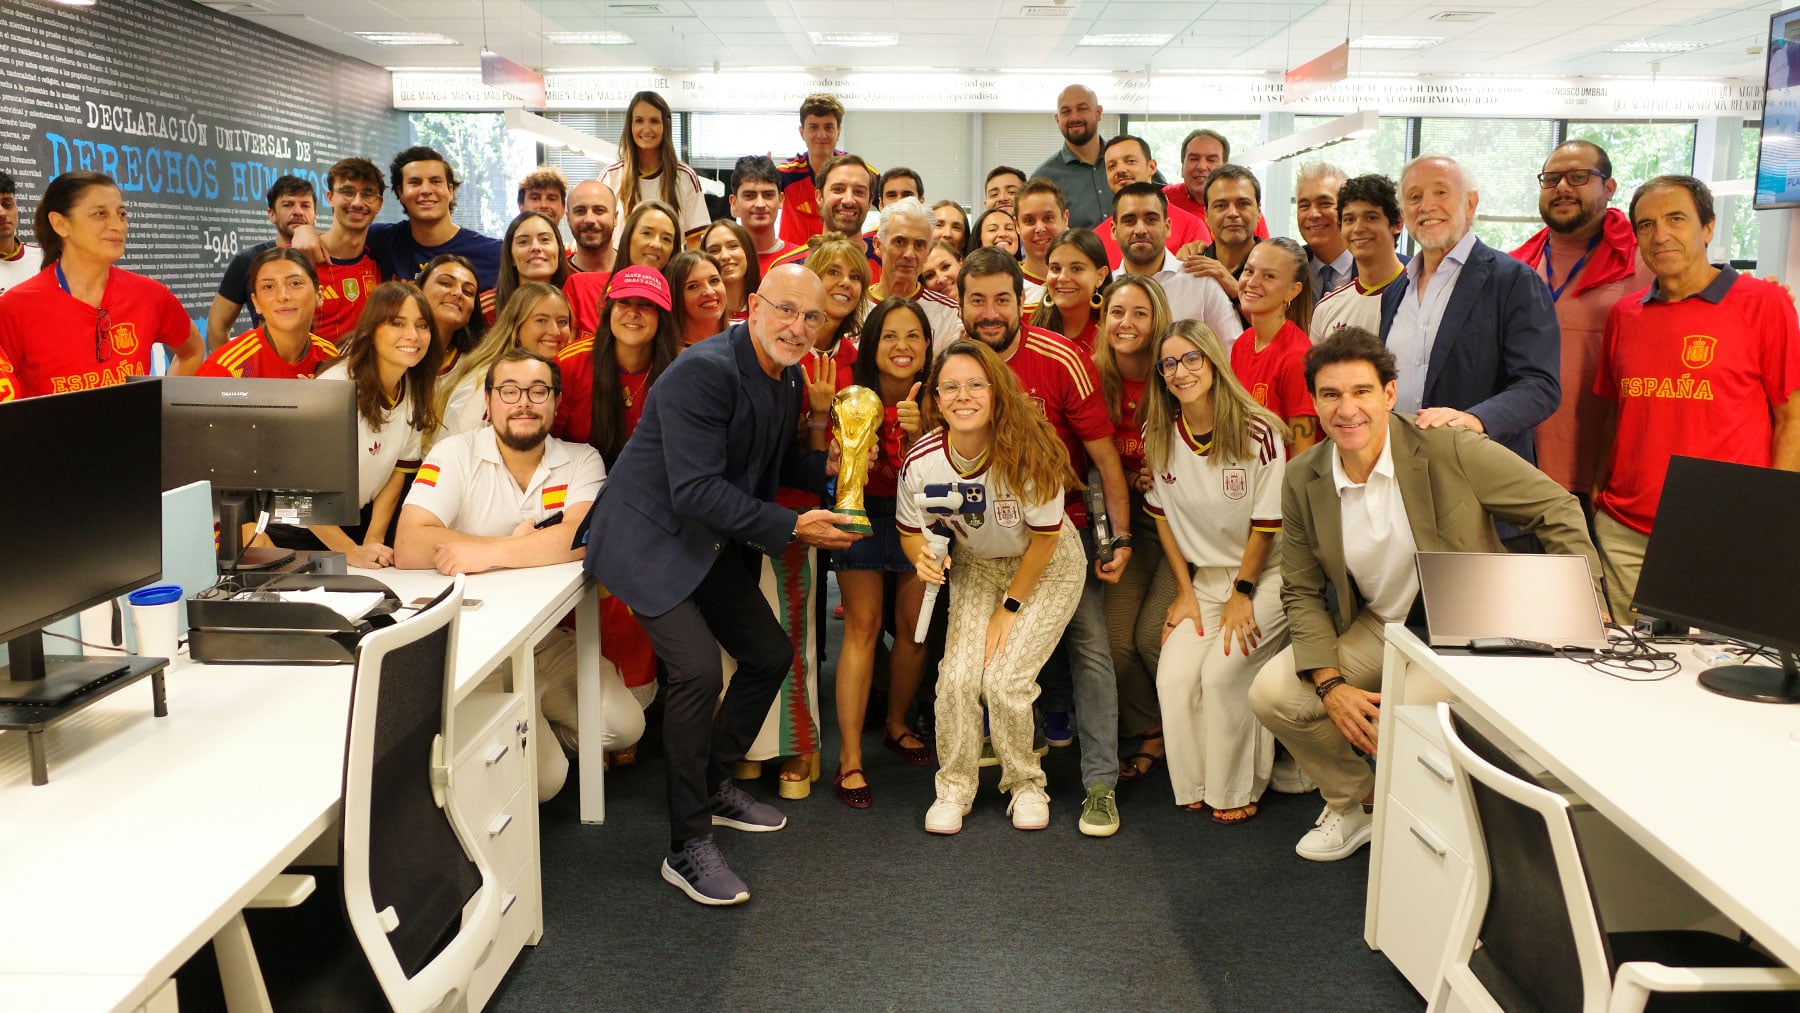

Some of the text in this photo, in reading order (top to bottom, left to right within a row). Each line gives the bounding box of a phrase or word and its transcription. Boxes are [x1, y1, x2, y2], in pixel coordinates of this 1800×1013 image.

[8, 21, 30, 32] mientras
[45, 30, 60, 39] pruebe
[10, 34, 32, 44] momento
[55, 55, 74, 66] territorio
[25, 61, 37, 69] actos
[38, 64, 58, 74] opuestos
[6, 70, 36, 81] nacionalidad
[654, 78, 669, 88] DEL
[980, 80, 997, 89] que
[24, 85, 48, 95] protección
[61, 92, 79, 101] sociedad
[401, 91, 416, 101] QUE
[452, 91, 480, 101] MIENTE
[954, 91, 998, 102] periodista
[1581, 88, 1608, 96] UMBRAL
[2, 94, 21, 102] persona
[23, 96, 34, 104] tiene
[36, 98, 53, 108] derecho
[64, 103, 80, 112] libertad
[64, 115, 76, 123] tanto
[86, 101, 208, 146] DECLARACIÓN
[215, 125, 291, 158] UNIVERSAL
[295, 139, 311, 162] DE
[2, 141, 22, 151] obligado
[10, 155, 36, 164] libremente
[45, 132, 219, 200] DERECHOS
[18, 169, 41, 177] autoridad
[203, 230, 239, 263] 1948
[51, 360, 145, 395] ESPAÑA
[1621, 373, 1714, 401] ESPAÑA
